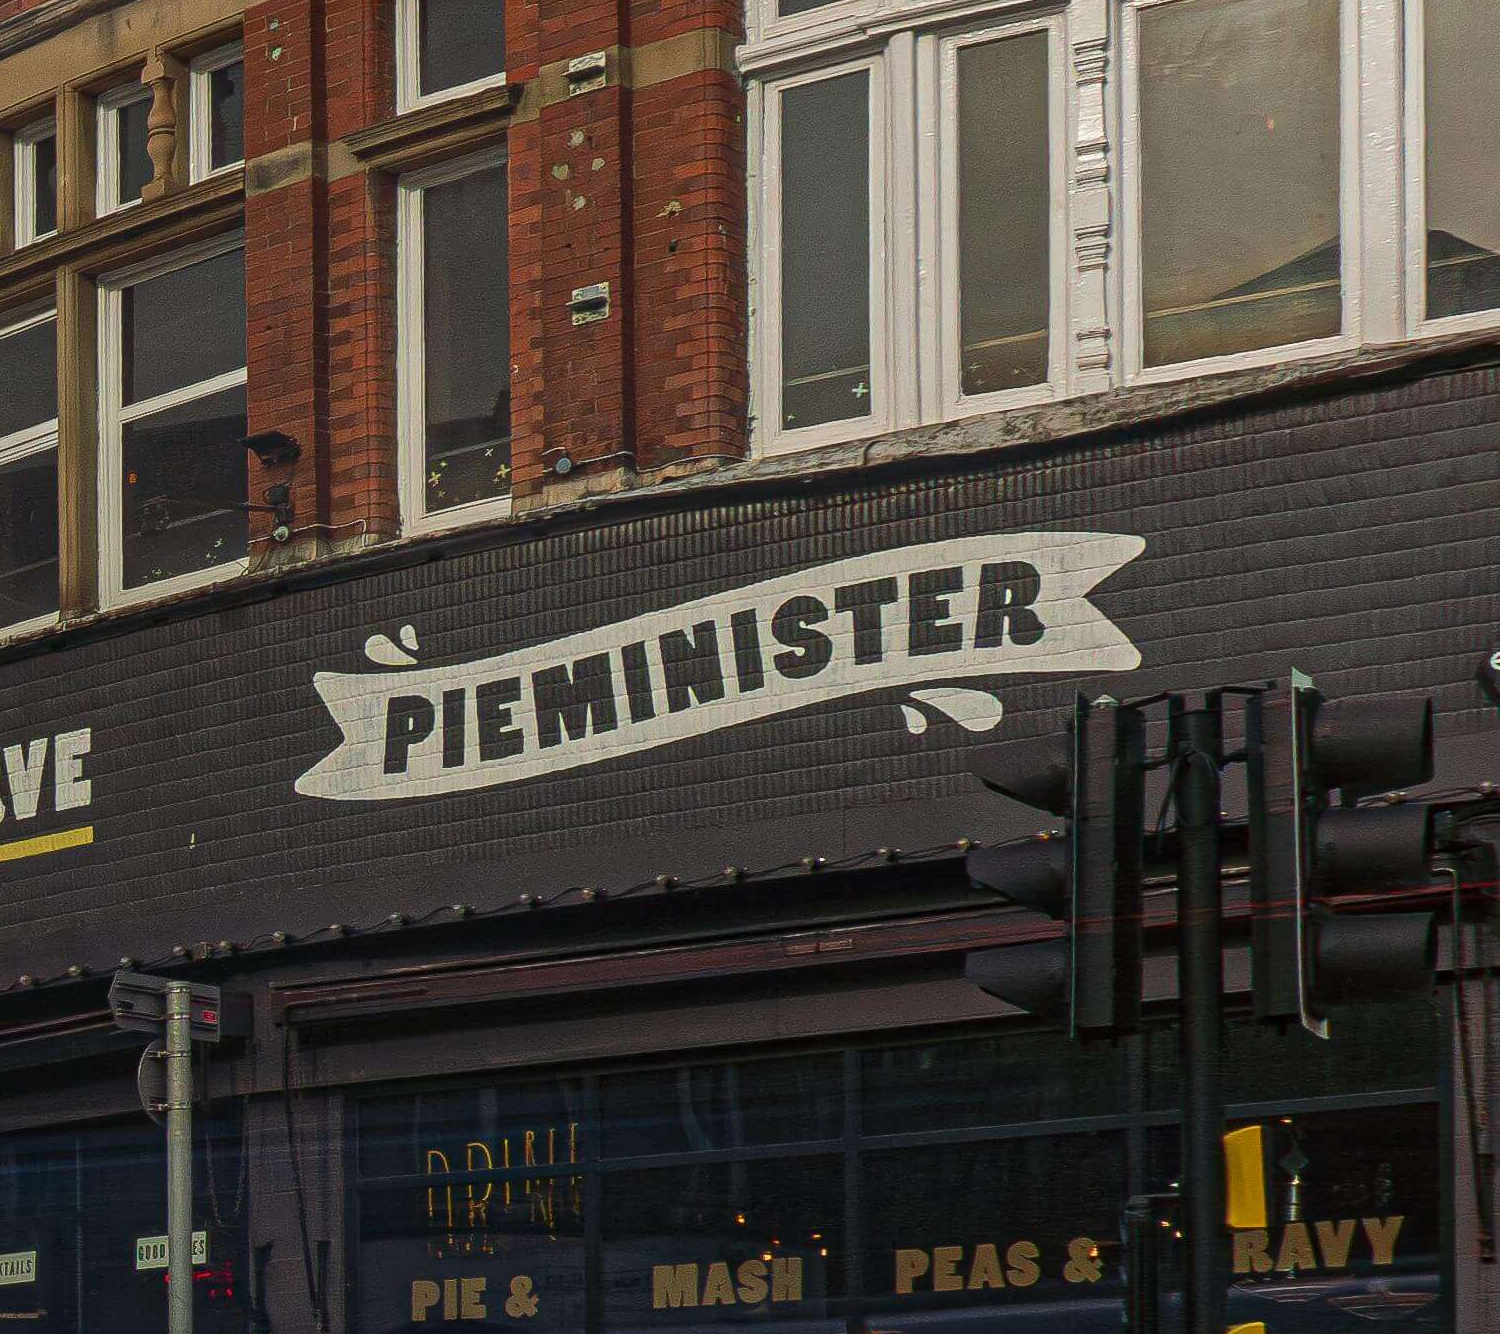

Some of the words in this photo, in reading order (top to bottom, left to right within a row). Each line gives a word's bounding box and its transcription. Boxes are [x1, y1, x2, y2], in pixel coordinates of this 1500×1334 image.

[381, 560, 1047, 775] PIEMINISTER
[138, 1243, 166, 1261] GOOD
[411, 1276, 487, 1322] PIE
[504, 1275, 539, 1318] &
[652, 1257, 803, 1309] MASH
[895, 1239, 1042, 1294] PEAS
[1062, 1237, 1102, 1284] &
[1232, 1215, 1405, 1273] RAVY
